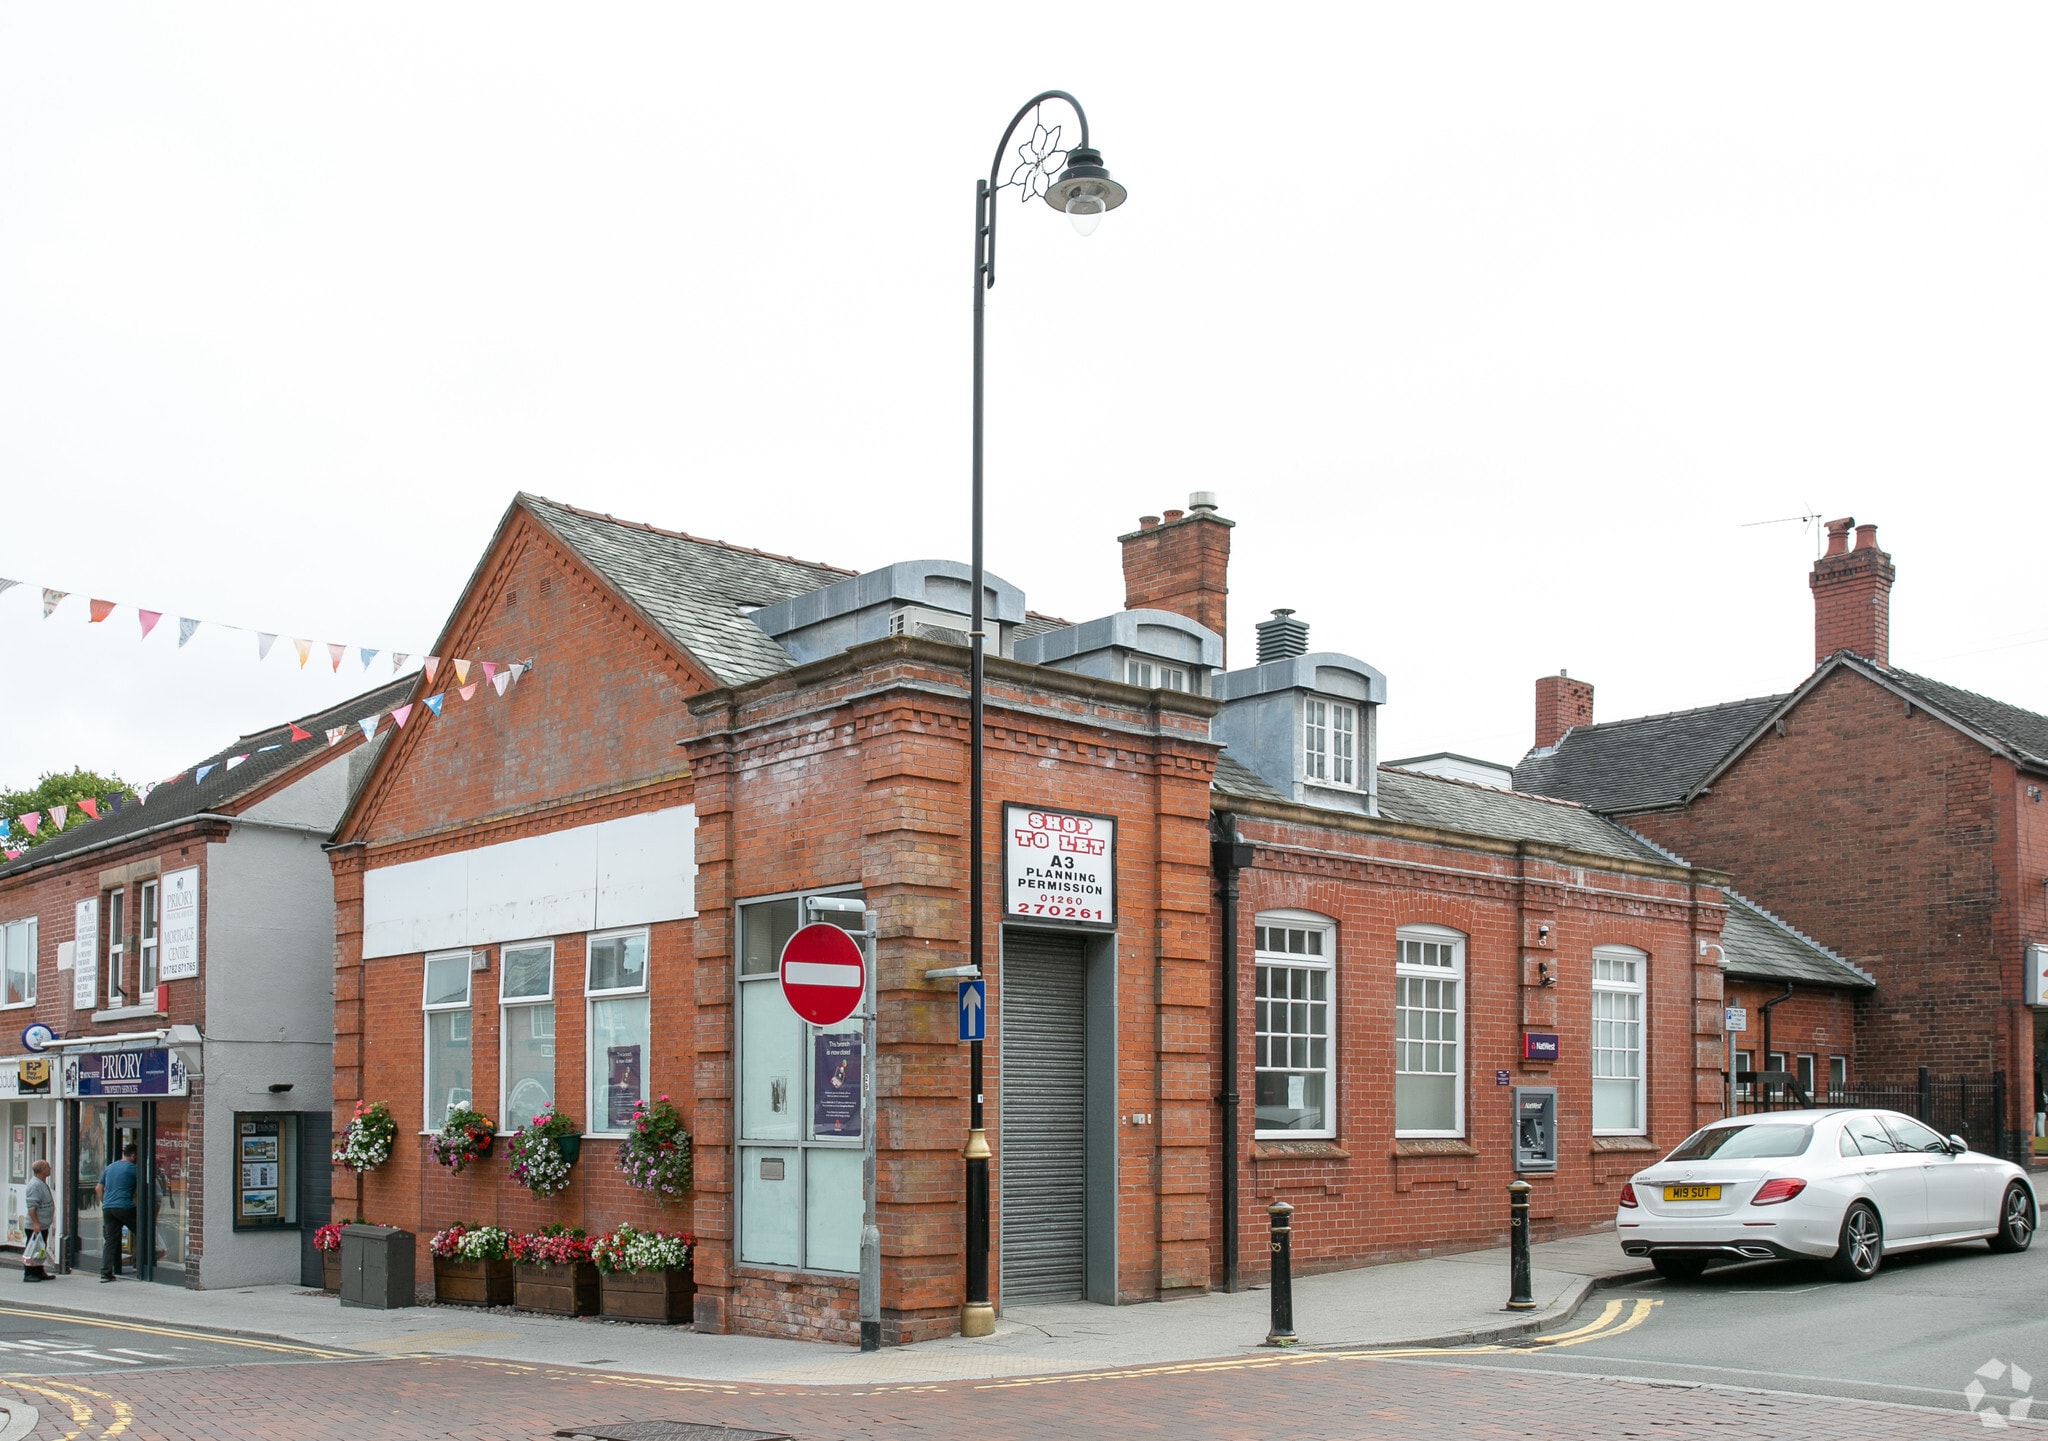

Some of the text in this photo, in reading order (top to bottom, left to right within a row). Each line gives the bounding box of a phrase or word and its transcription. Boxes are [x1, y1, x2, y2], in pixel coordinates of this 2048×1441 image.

[1028, 812, 1093, 835] SHOP
[1015, 829, 1105, 856] TO LET
[1050, 855, 1074, 869] A3
[1026, 867, 1096, 883] PLANNING
[1018, 878, 1102, 895] PERMISSION
[167, 890, 194, 909] PRIORY
[1040, 894, 1083, 905] 01260
[1018, 903, 1102, 920] 270261
[164, 927, 195, 944] MORTGAGE
[168, 945, 189, 961] CENTRE
[163, 962, 196, 975] 01782 871765
[1536, 1042, 1556, 1050] NatWest
[101, 1053, 142, 1079] PRIORY
[1673, 1187, 1711, 1198] M19 SUT
